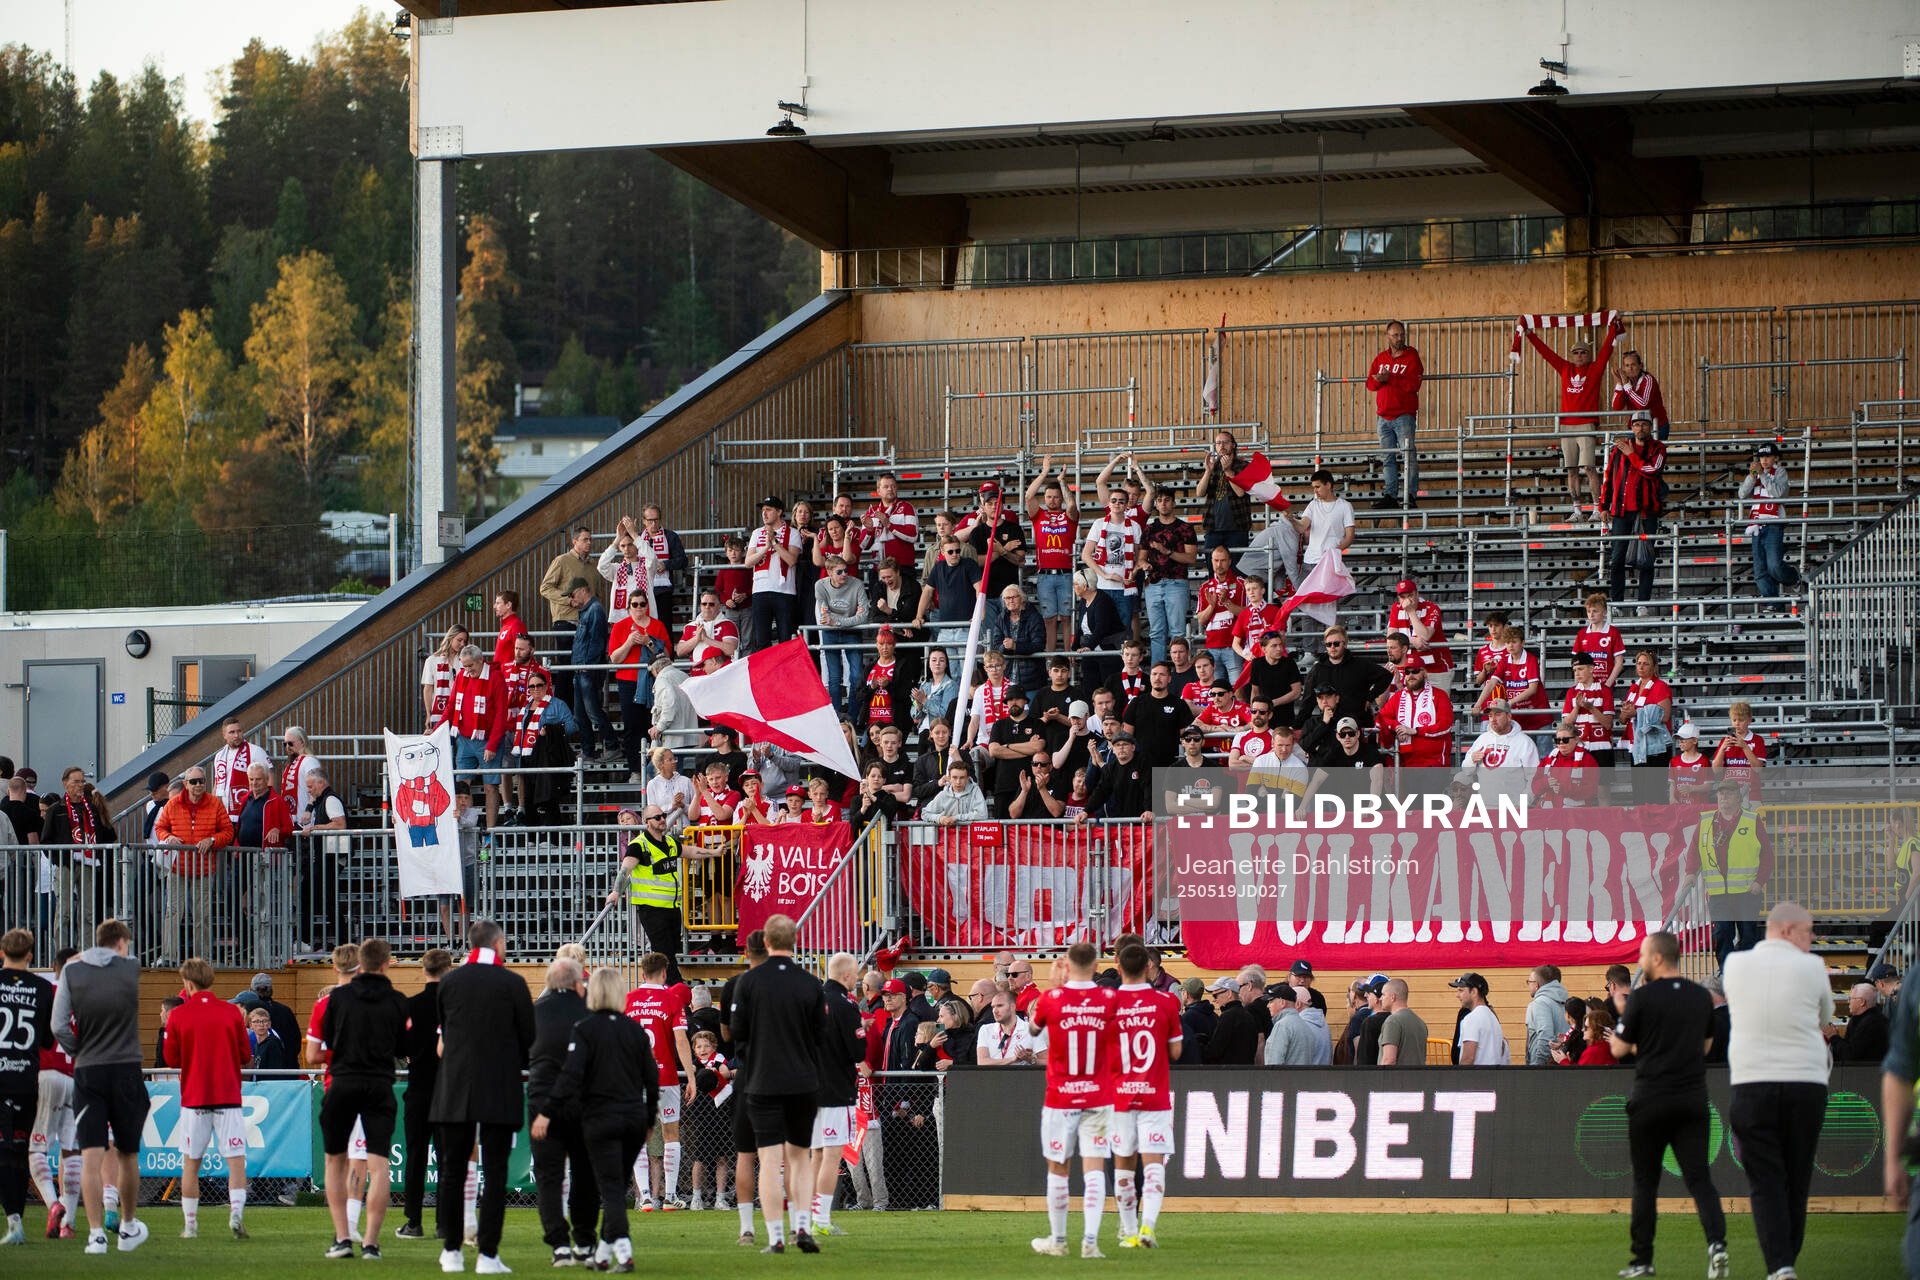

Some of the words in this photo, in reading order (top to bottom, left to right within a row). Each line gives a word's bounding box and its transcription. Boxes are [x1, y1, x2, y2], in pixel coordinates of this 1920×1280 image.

[113, 694, 123, 703] WC
[779, 846, 843, 869] VALLA
[1, 993, 37, 1007] ORSELL
[0, 1006, 35, 1050] 25
[1060, 1015, 1106, 1030] GRAVIUS
[1118, 1016, 1156, 1029] FARAJ
[640, 1018, 656, 1049] 5
[1068, 1030, 1096, 1075] 11
[1119, 1030, 1156, 1074] 19
[663, 1107, 676, 1116] ICA
[229, 1137, 244, 1147] ICA
[1149, 1133, 1165, 1143] ICA
[1169, 1091, 1497, 1180] NIBET
